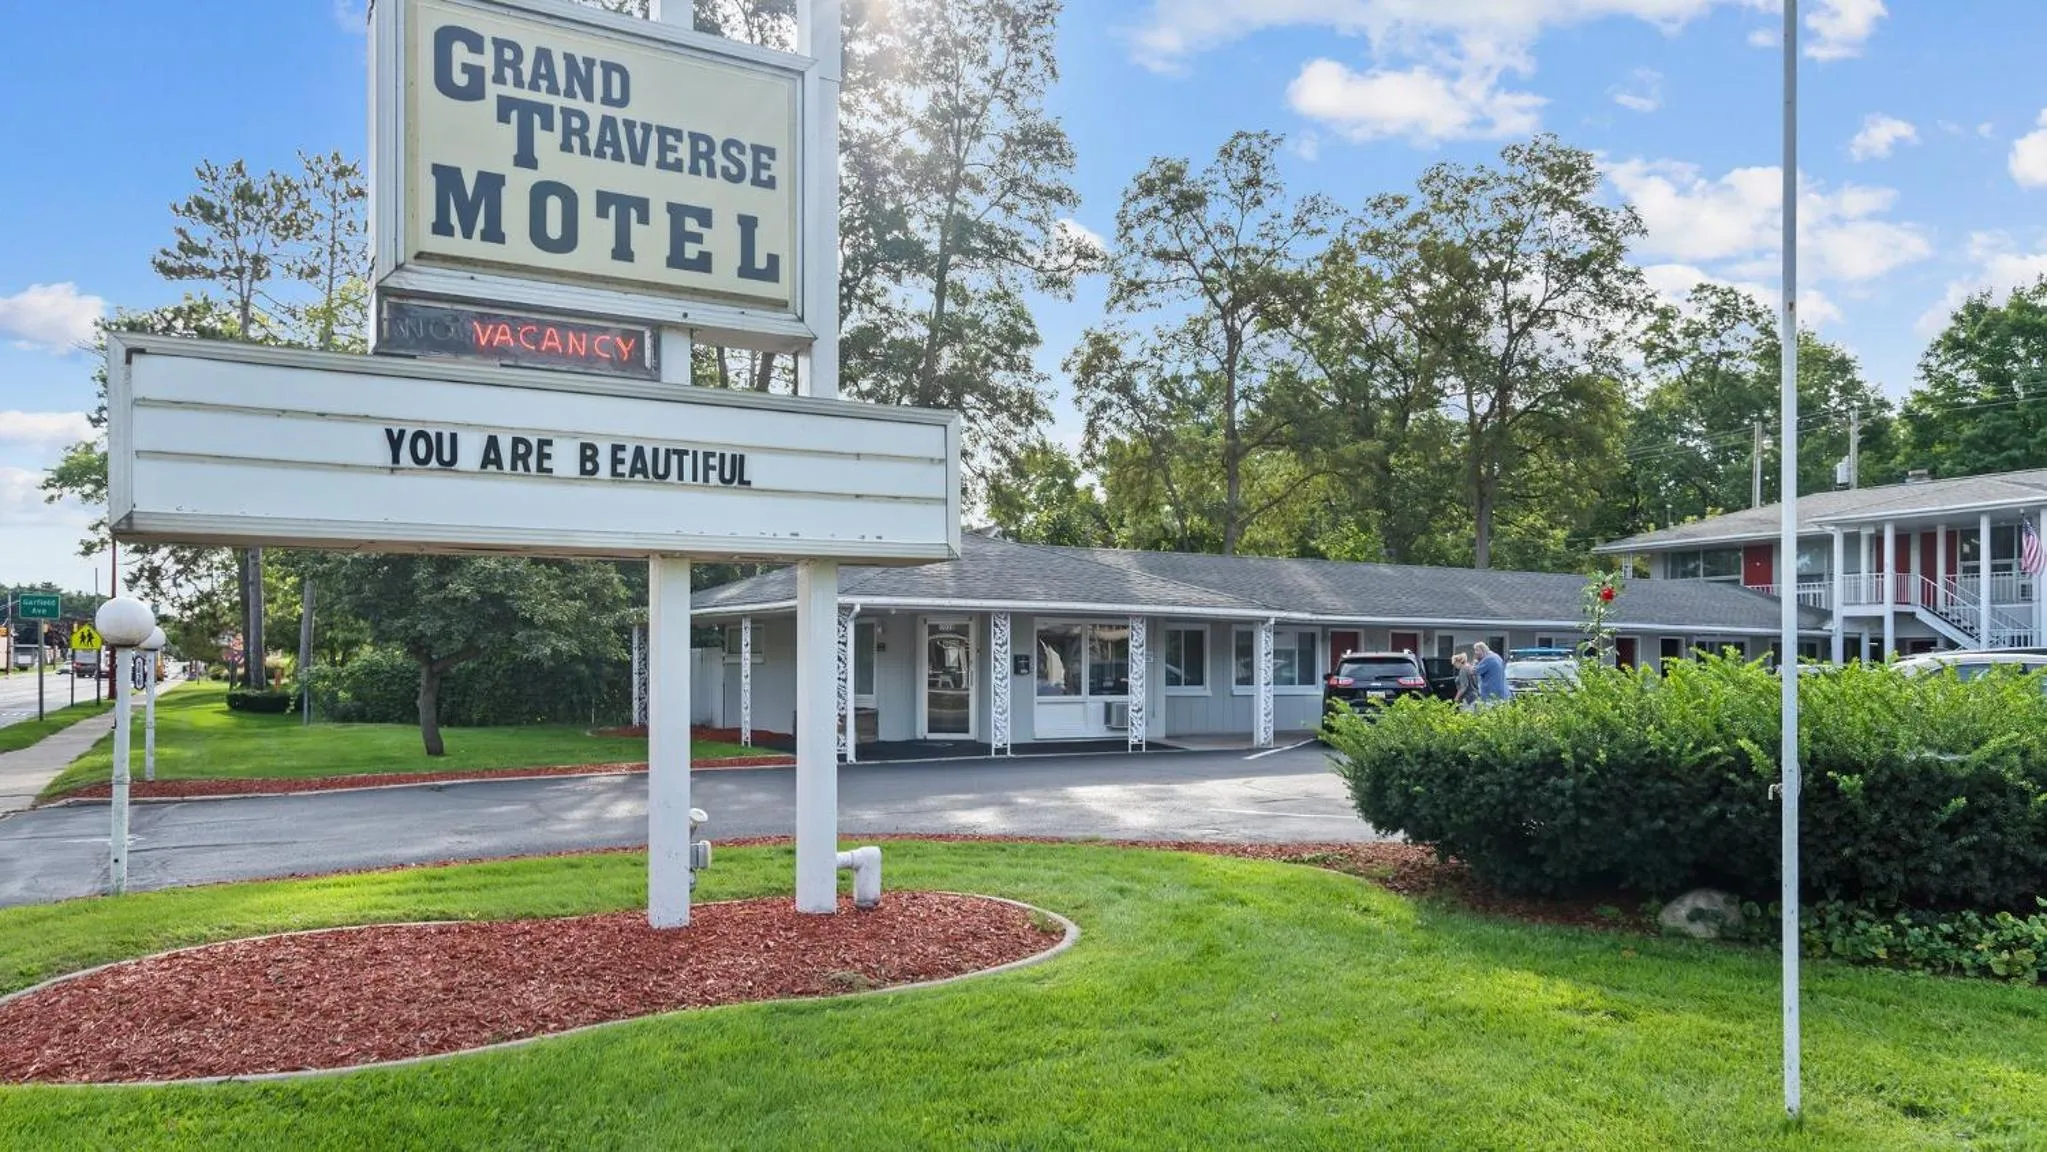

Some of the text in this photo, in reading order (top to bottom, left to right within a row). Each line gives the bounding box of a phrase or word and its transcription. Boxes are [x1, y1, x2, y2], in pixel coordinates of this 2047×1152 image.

[434, 25, 631, 109] GRAND
[496, 94, 777, 190] TRAVERSE
[431, 163, 780, 283] MOTEL
[473, 321, 635, 361] VACANCY
[385, 428, 752, 487] YOU ARE BEAUTIFUL
